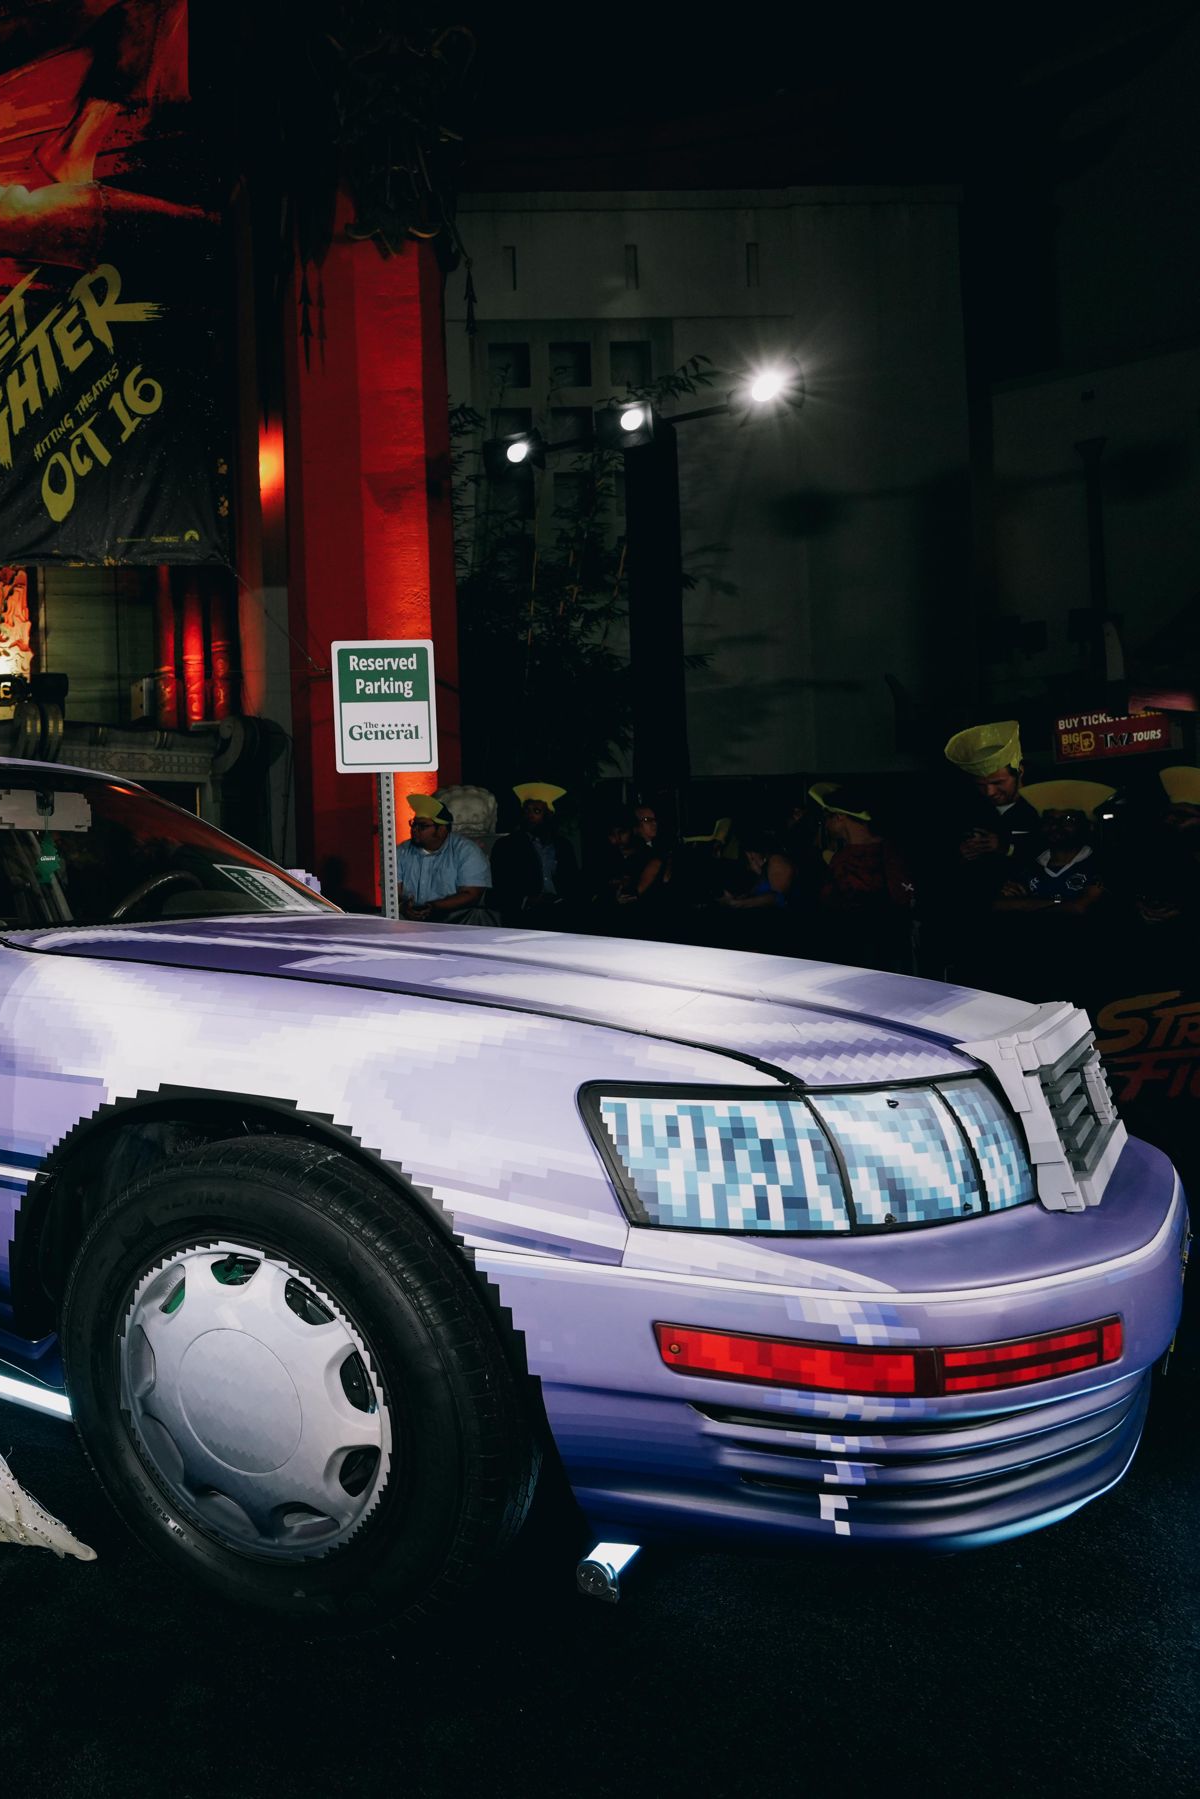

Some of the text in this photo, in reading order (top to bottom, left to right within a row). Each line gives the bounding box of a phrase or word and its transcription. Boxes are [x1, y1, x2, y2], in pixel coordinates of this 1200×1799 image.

[33, 362, 120, 462] HITTING THEATRES
[41, 364, 163, 523] OCT 16
[349, 654, 417, 671] Reserved
[355, 677, 413, 698] Parking
[364, 721, 379, 729] The
[1058, 717, 1080, 730] BUY
[348, 724, 420, 742] General
[1061, 732, 1081, 745] BIG
[1132, 729, 1162, 743] TOURS
